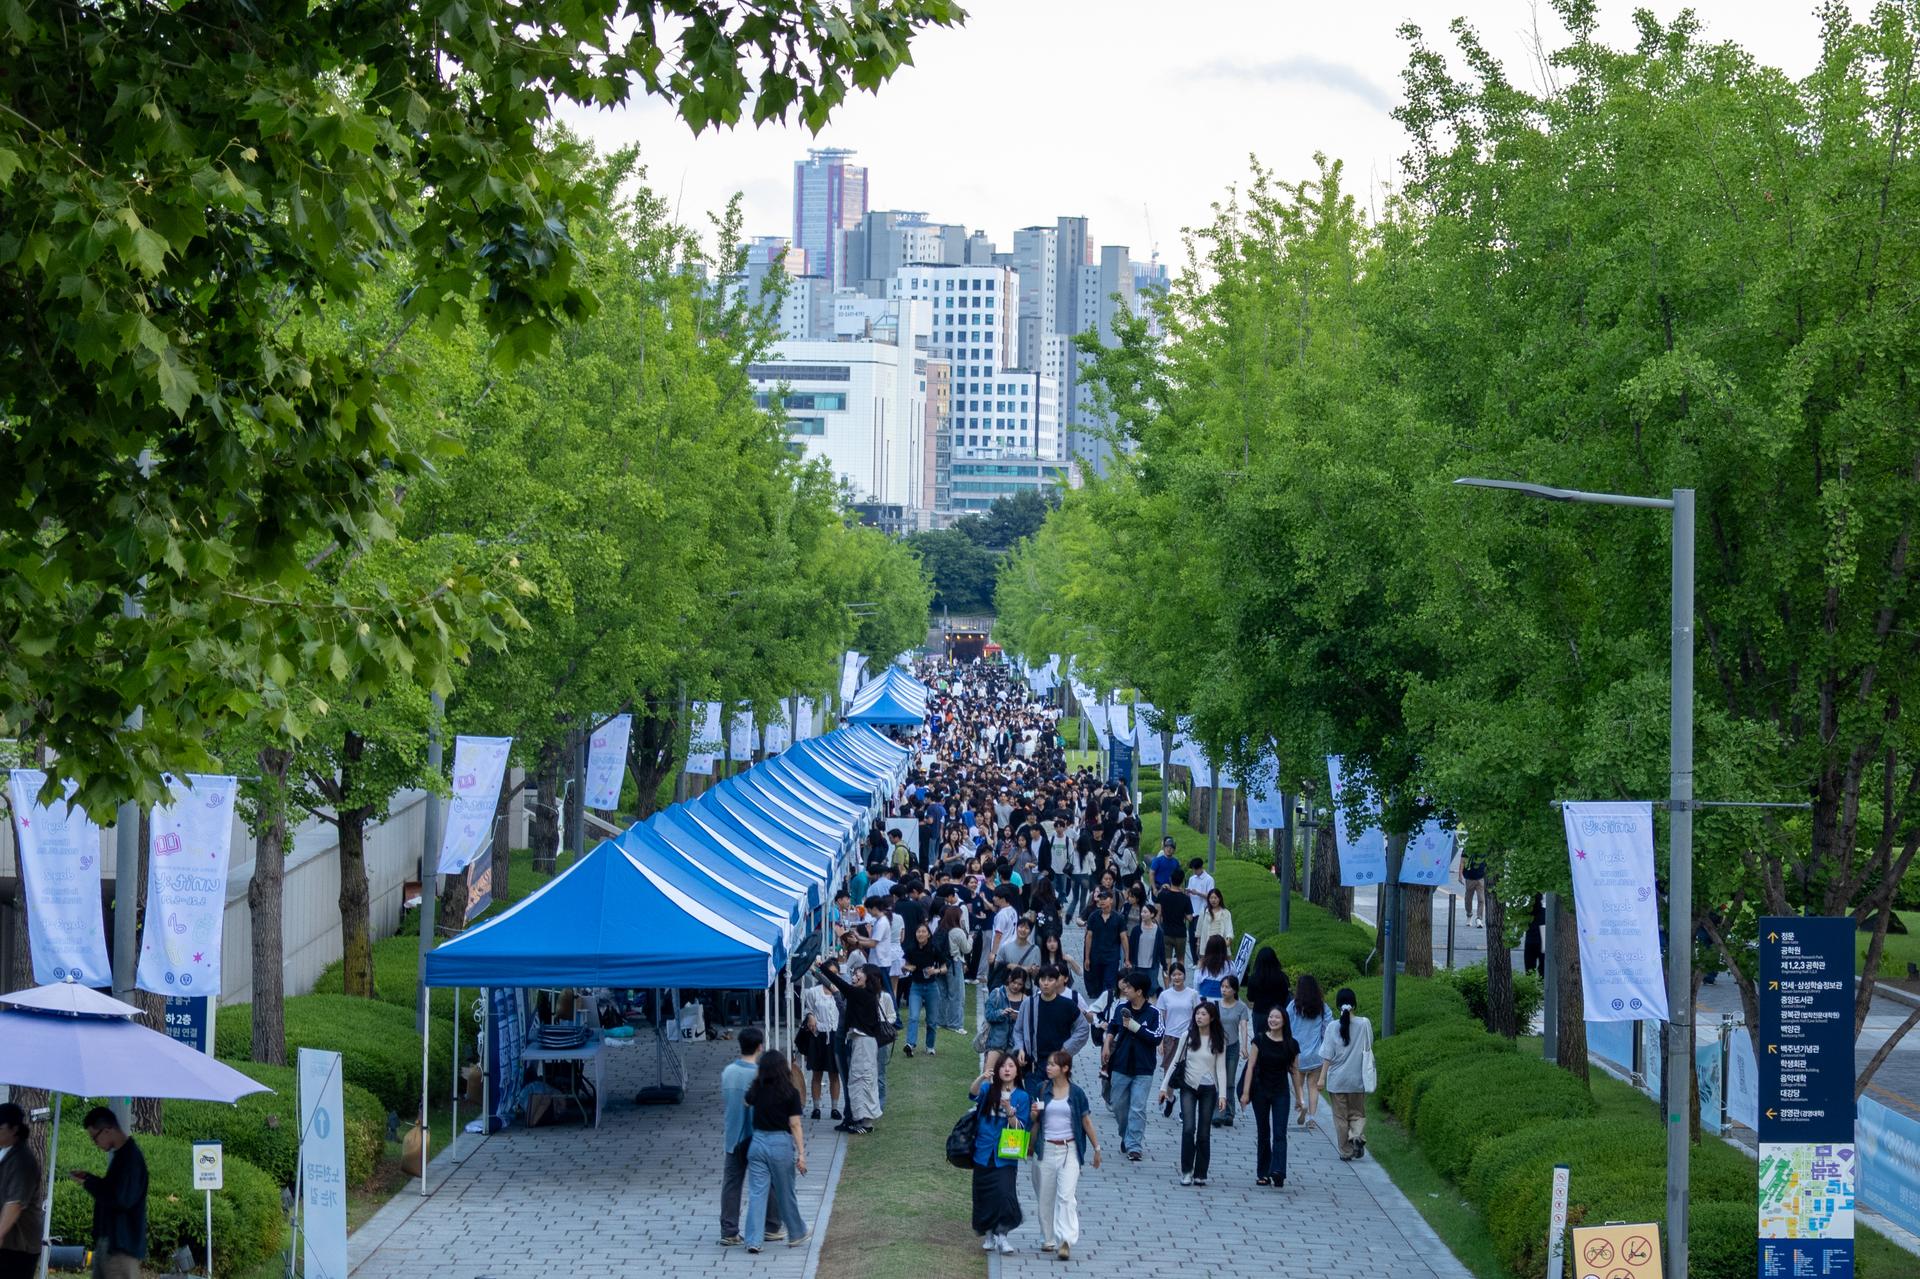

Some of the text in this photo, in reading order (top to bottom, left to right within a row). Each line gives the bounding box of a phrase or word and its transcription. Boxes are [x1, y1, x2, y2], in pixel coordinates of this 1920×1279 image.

[1781, 932, 1795, 941] 정문
[1781, 946, 1801, 955] 공학원
[1781, 996, 1813, 1004] 중앙도서관
[1780, 1045, 1819, 1054] 백주년기념관
[1780, 1059, 1807, 1068] 학생회관
[1780, 1074, 1807, 1083] 음악대학
[1780, 1089, 1800, 1098] 대강당
[1780, 1109, 1800, 1118] 경영관
